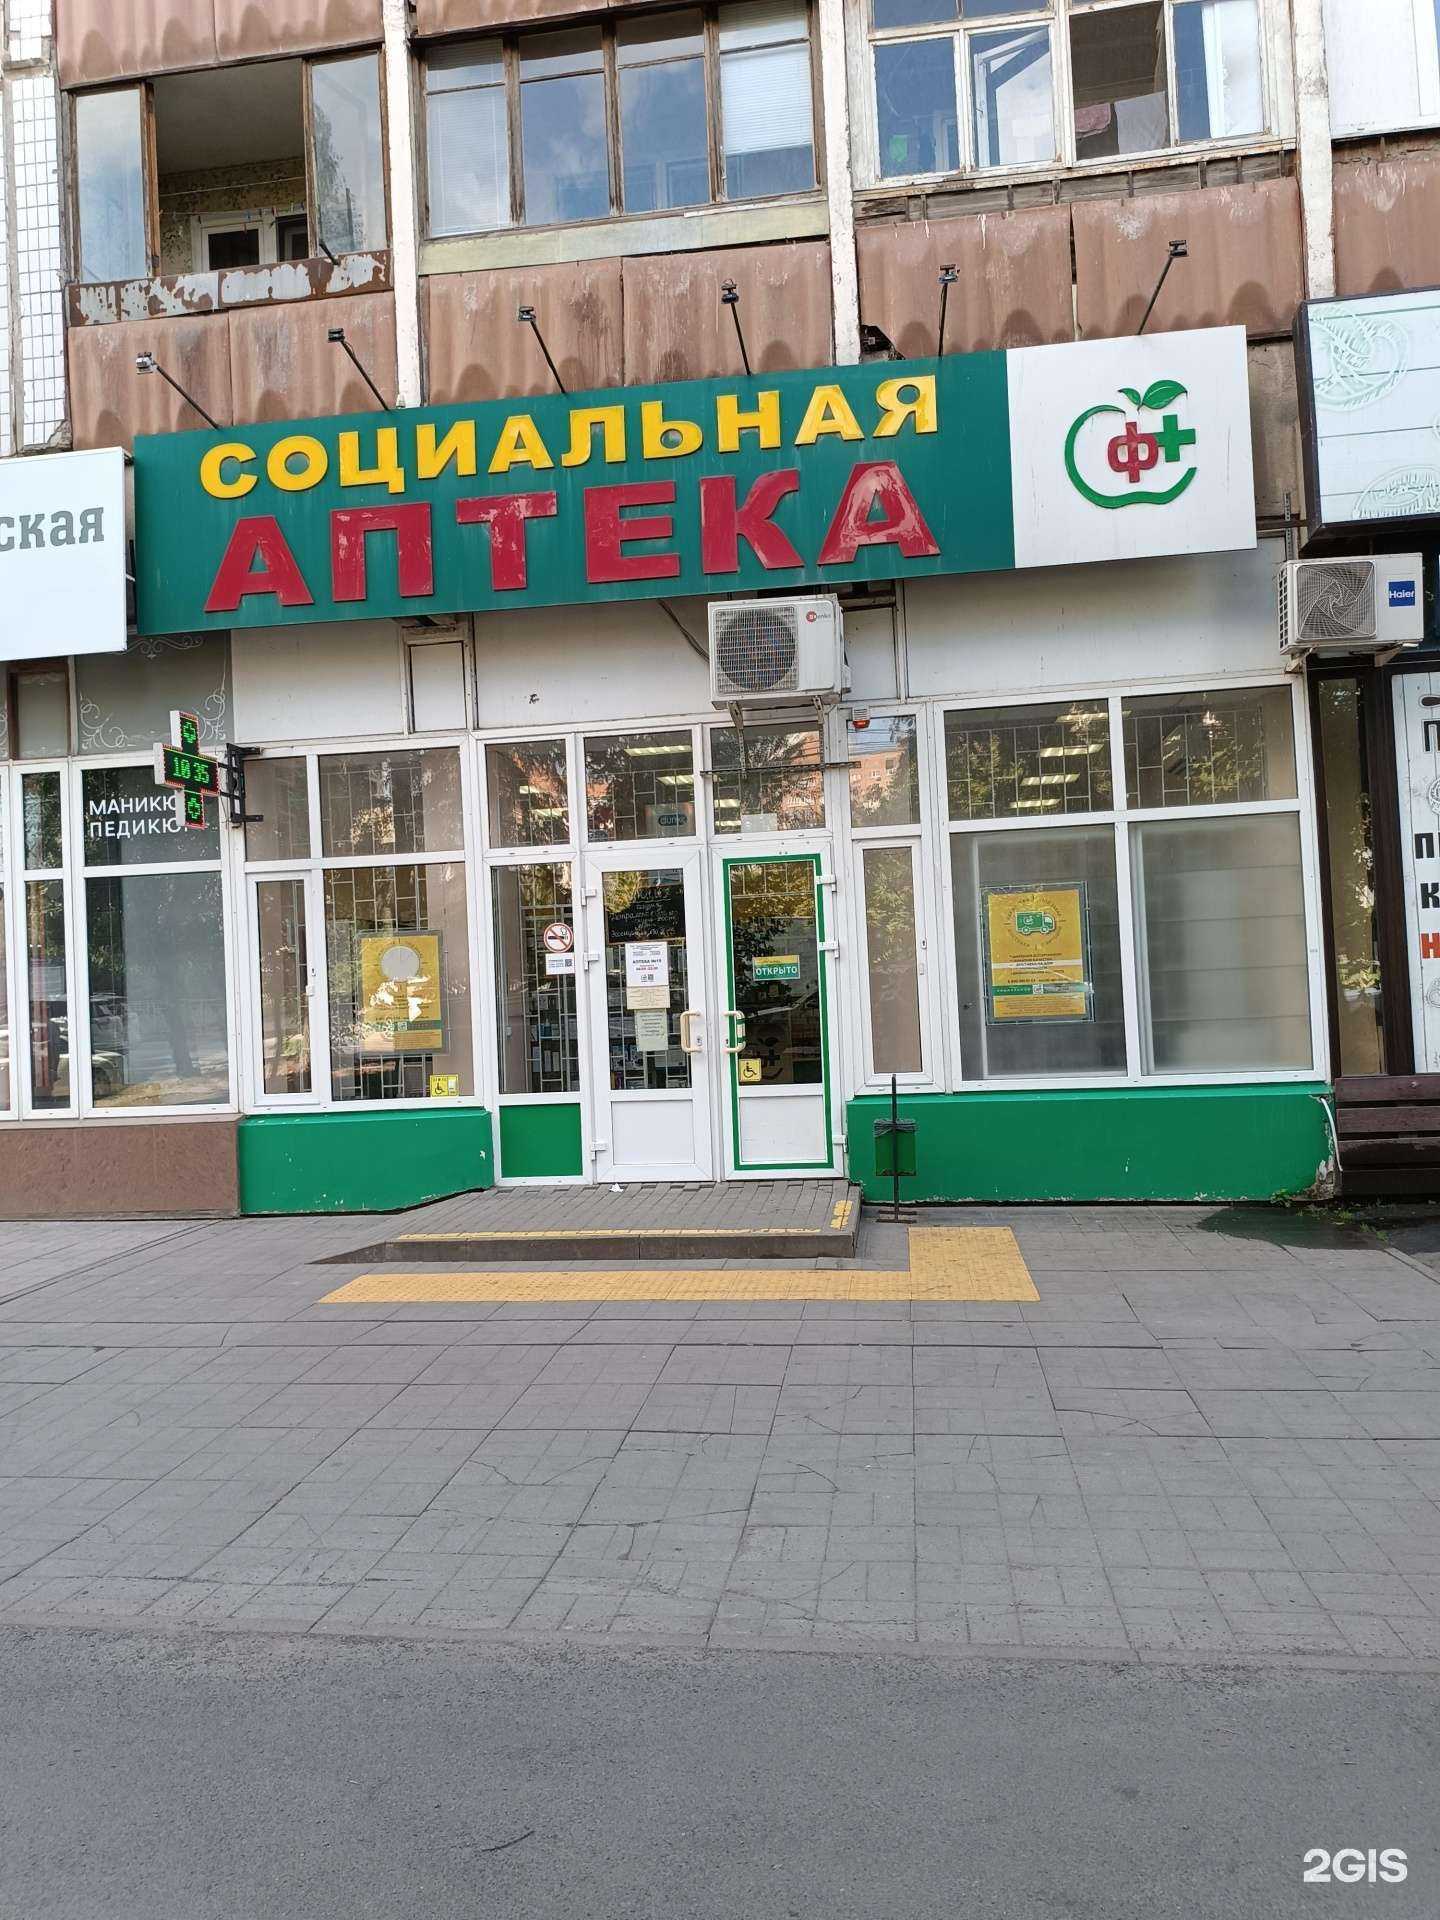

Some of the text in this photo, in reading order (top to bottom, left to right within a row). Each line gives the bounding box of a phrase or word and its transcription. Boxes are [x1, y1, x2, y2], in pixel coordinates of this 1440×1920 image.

[200, 375, 938, 498] СОЦИАЛЬНАЯ
[204, 459, 942, 613] АПТЕКА
[1389, 589, 1415, 599] Haier
[89, 796, 177, 816] МАНИКЮ
[89, 818, 188, 840] ПЕДИКЮ
[755, 966, 798, 976] ОТКРЫТО
